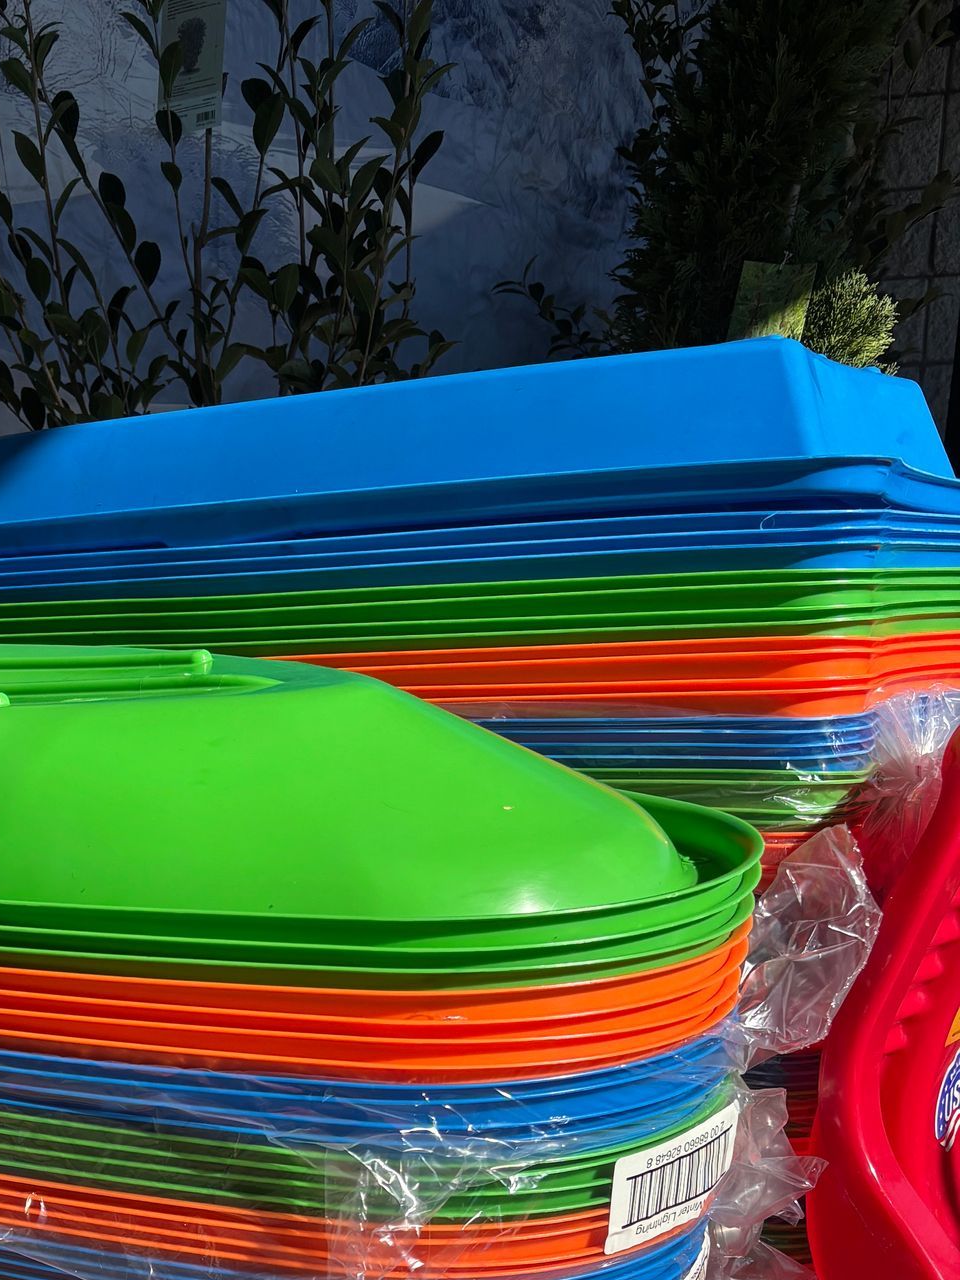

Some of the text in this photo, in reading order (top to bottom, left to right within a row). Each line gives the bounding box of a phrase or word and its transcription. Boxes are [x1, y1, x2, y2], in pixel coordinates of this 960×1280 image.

[683, 1131, 709, 1153] 68660
[710, 1124, 719, 1139] 00
[646, 1157, 653, 1169] 8
[655, 1144, 682, 1166] 82648
[635, 1211, 677, 1235] Lightning
